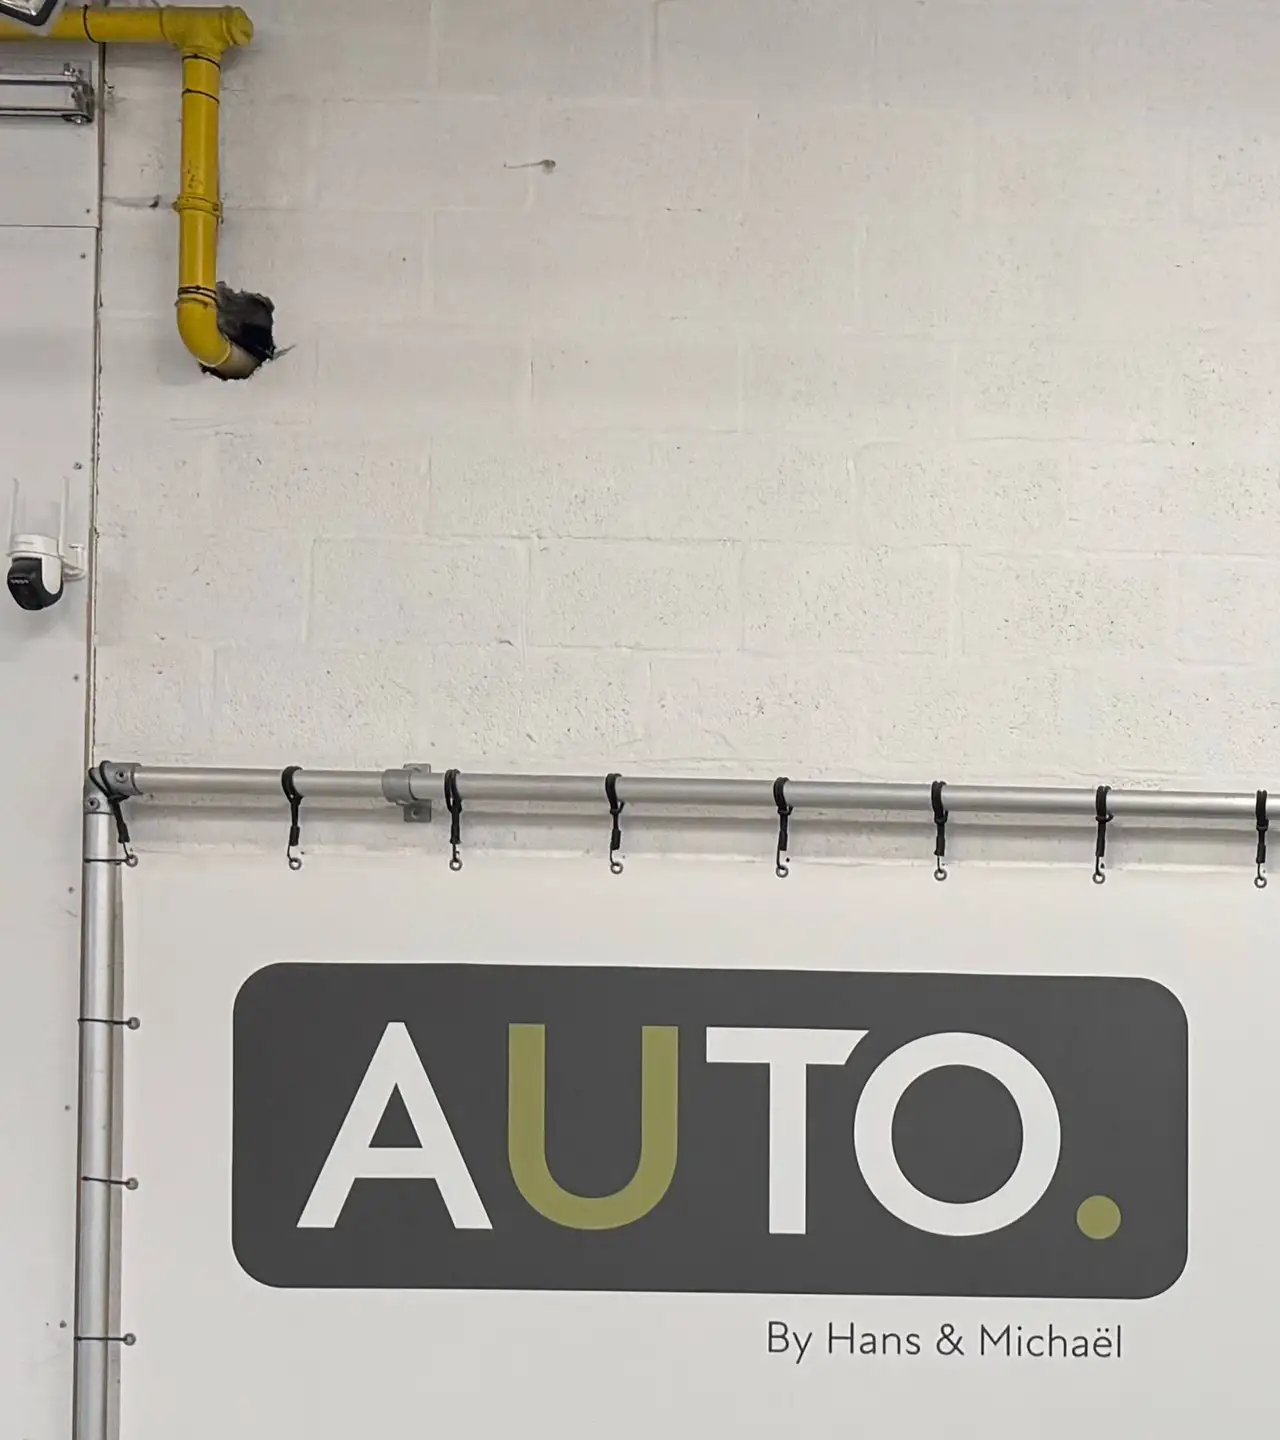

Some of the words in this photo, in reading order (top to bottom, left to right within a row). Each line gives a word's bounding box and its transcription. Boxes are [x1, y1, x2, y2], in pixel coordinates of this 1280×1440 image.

[768, 1321, 813, 1365] By
[828, 1322, 921, 1356] Hans
[936, 1323, 965, 1356] &
[980, 1322, 1121, 1357] Michaël
